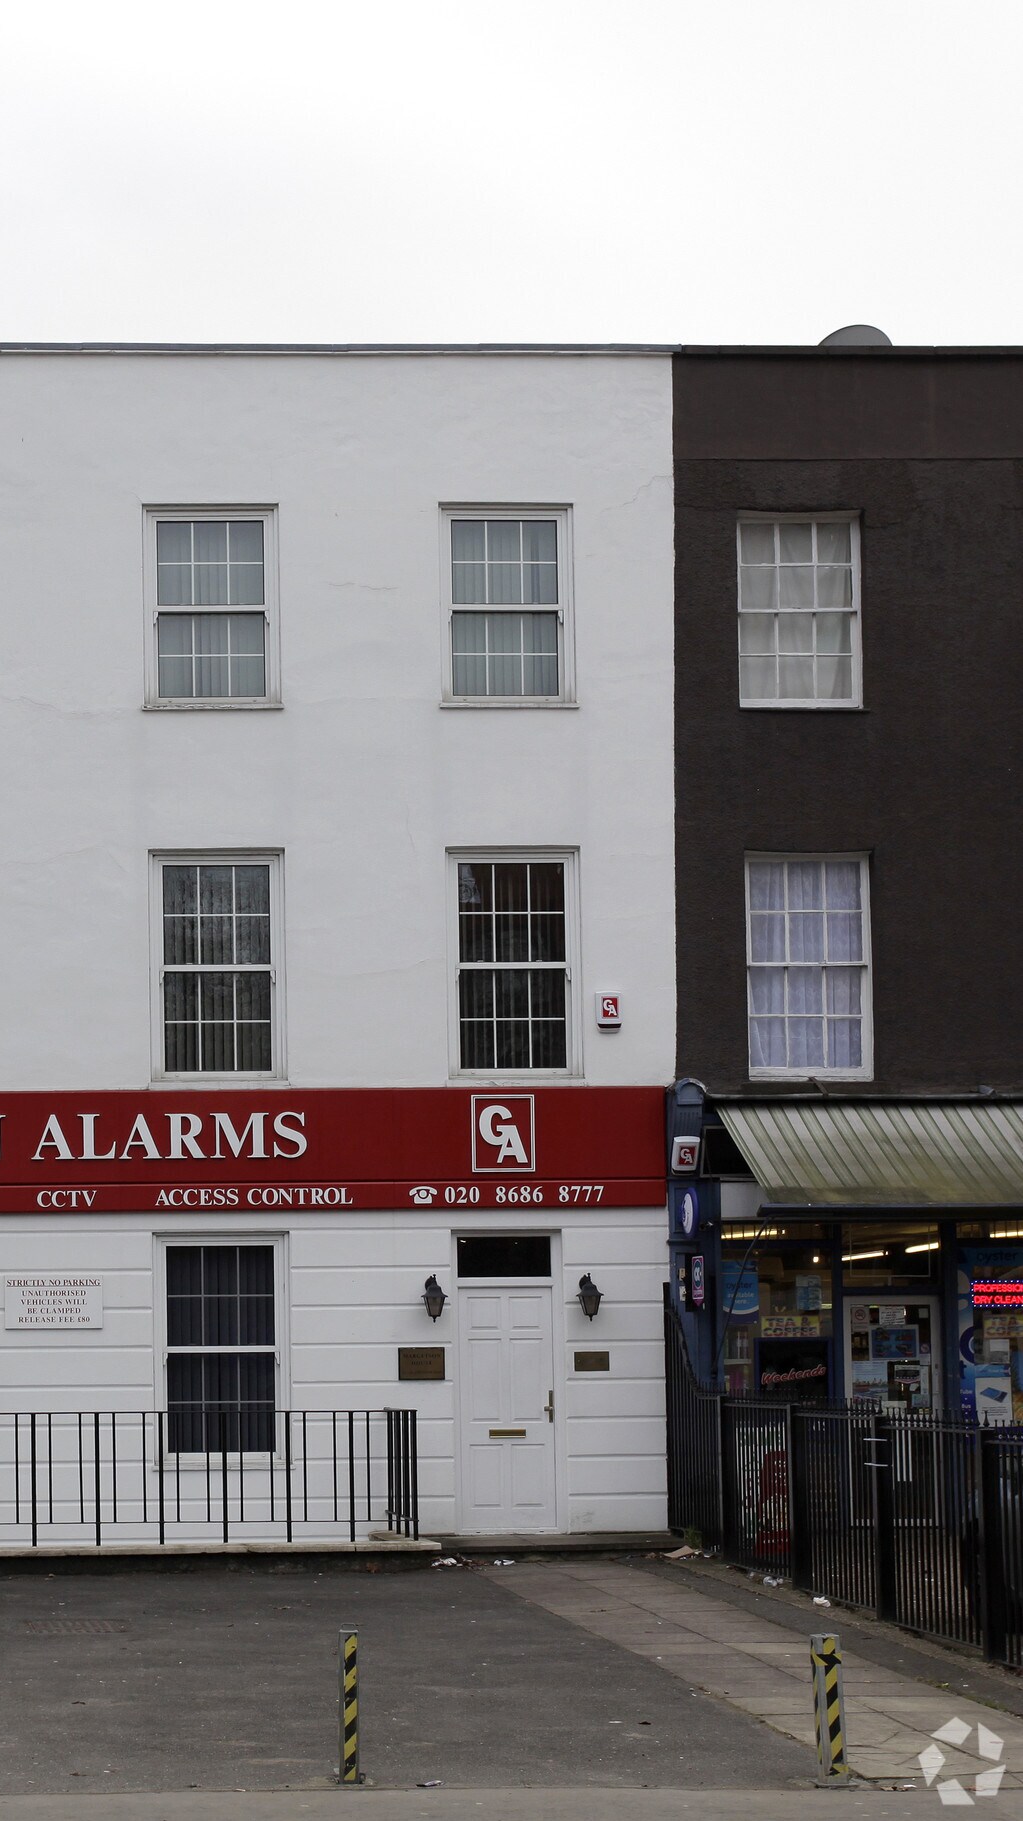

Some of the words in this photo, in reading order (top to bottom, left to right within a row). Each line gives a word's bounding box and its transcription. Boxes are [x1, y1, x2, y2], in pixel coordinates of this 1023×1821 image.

[603, 999, 618, 1016] GA
[30, 1107, 309, 1161] ALARMS
[478, 1104, 529, 1164] GA
[36, 1190, 97, 1208] CCTV
[155, 1188, 239, 1206] ACCESS
[246, 1187, 354, 1205] CONTROL
[444, 1186, 480, 1205] 020
[495, 1185, 544, 1204] 8686
[558, 1184, 604, 1203] 8777
[7, 1279, 46, 1287] STRICTLY
[973, 1284, 1023, 1293] PROFESSIO
[974, 1295, 993, 1304] DRY
[767, 1317, 795, 1327] TEA
[761, 1364, 826, 1385] Weekends
